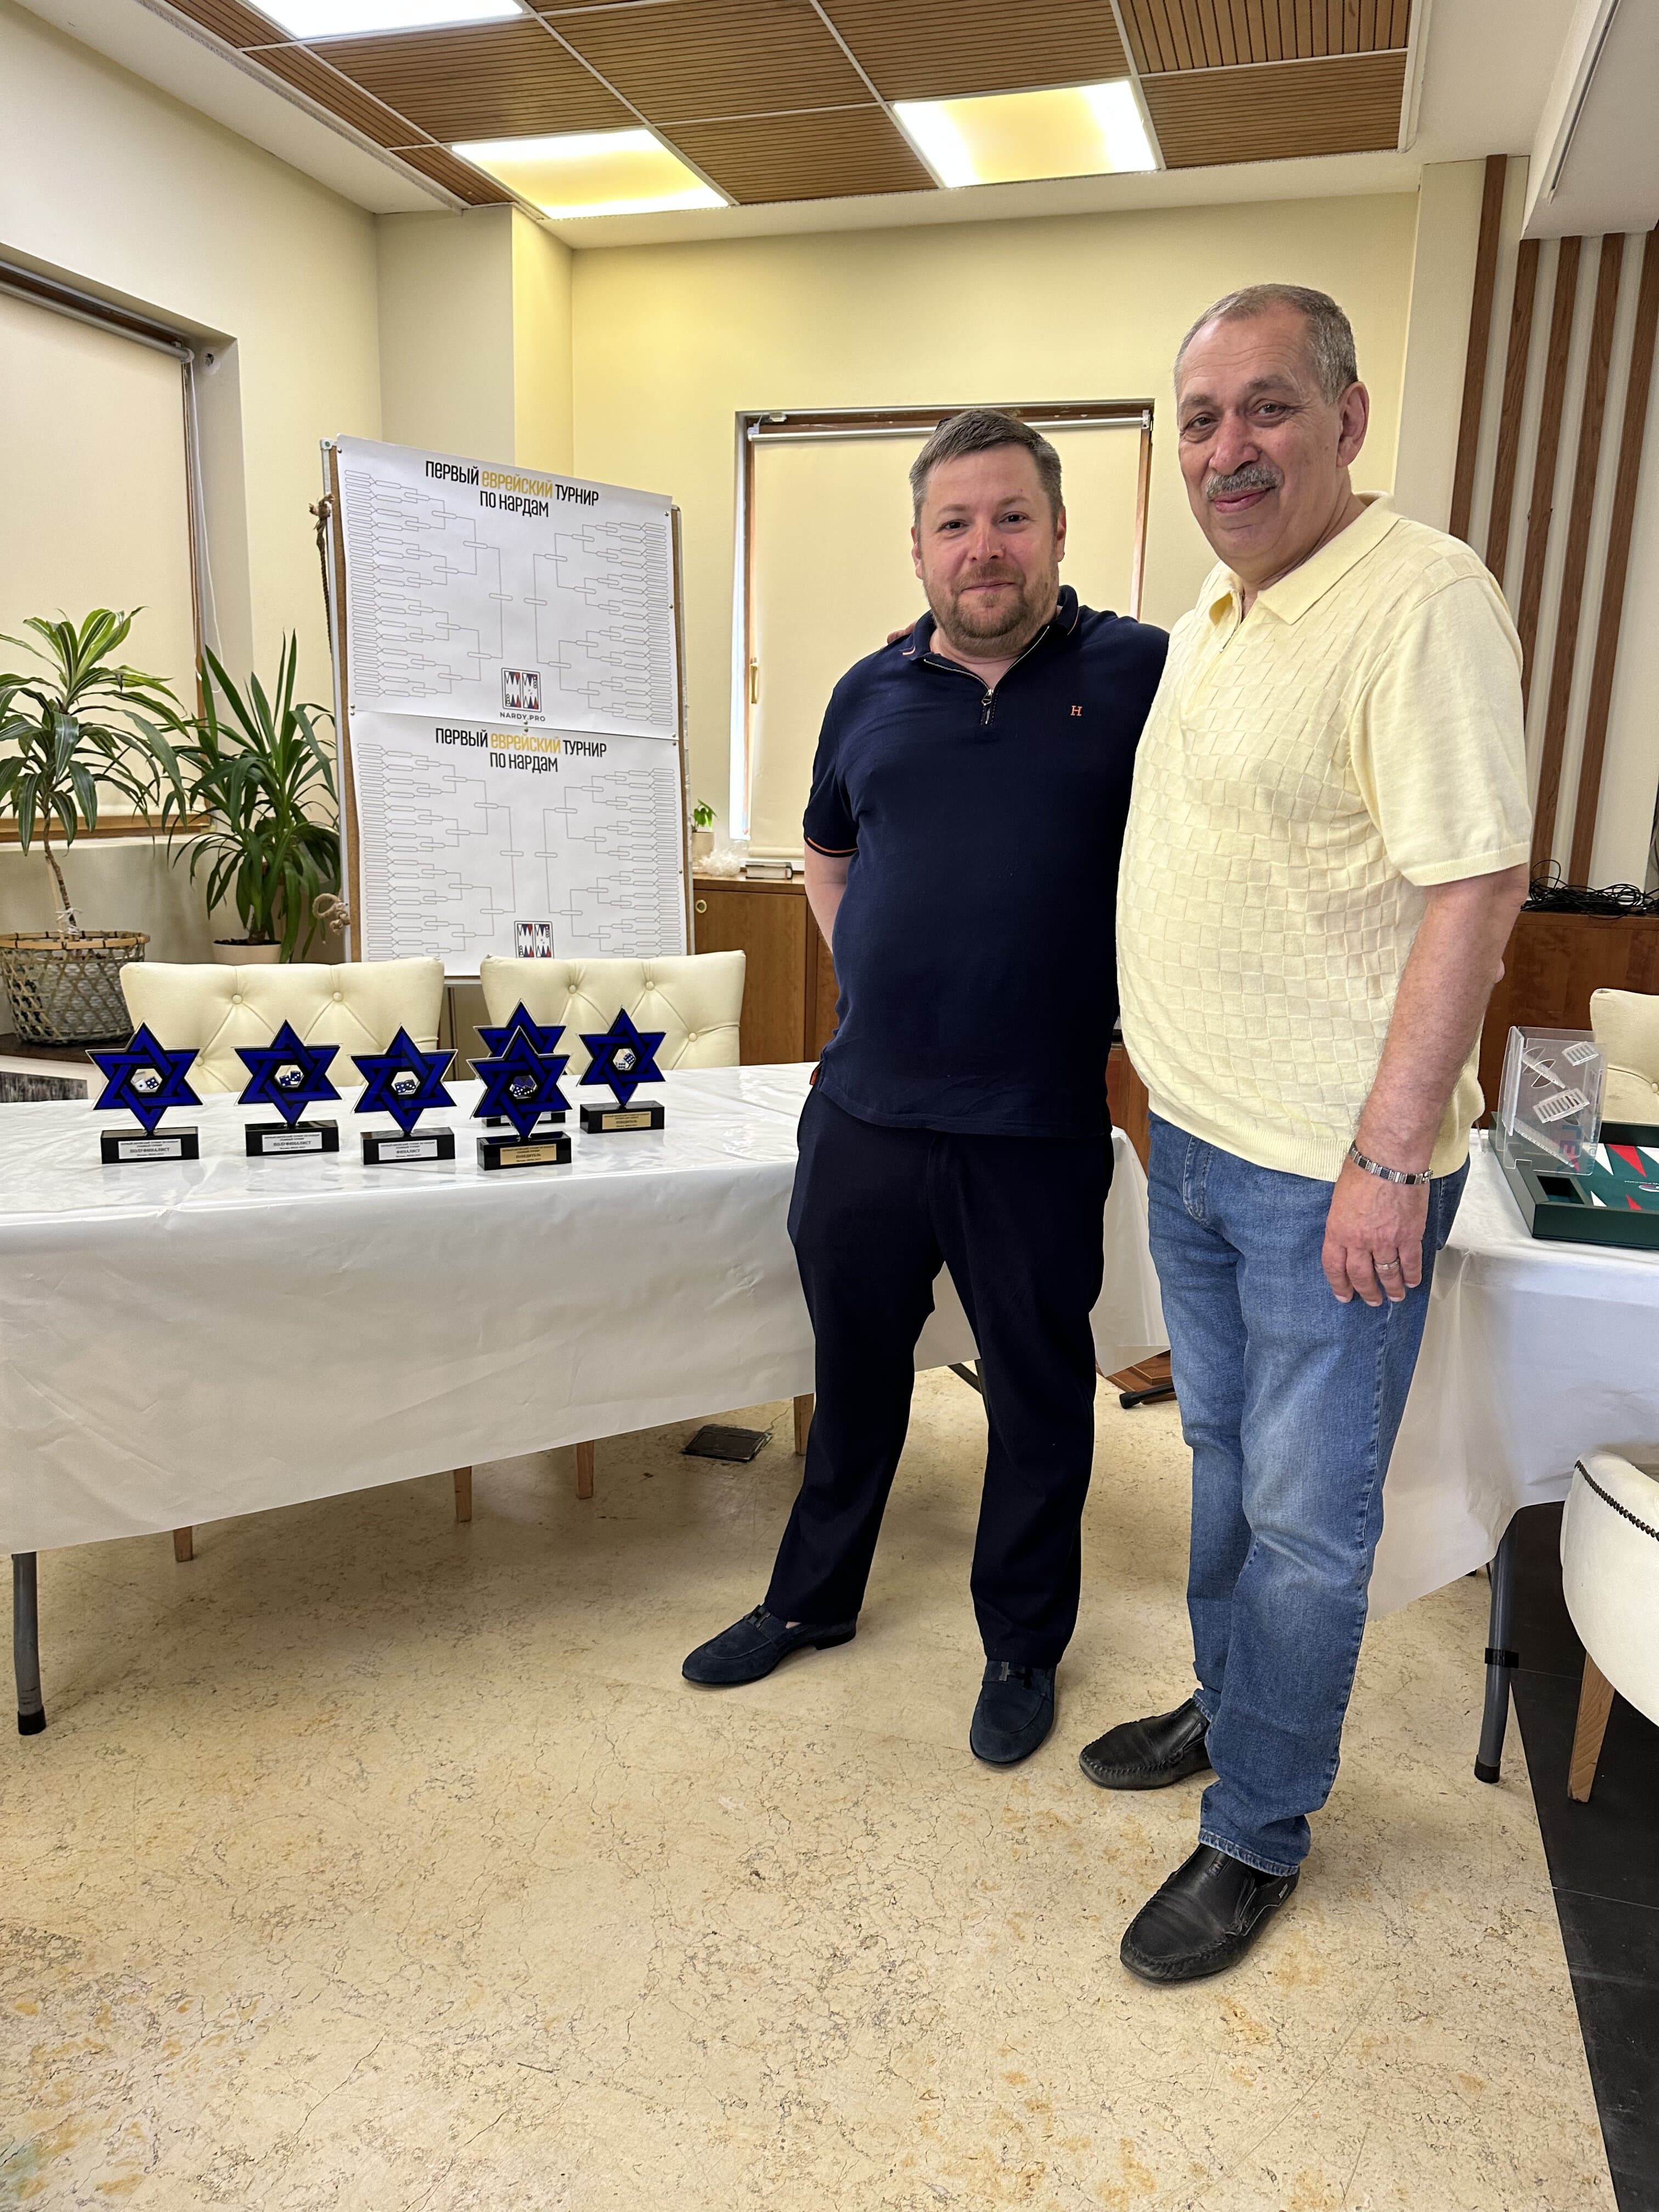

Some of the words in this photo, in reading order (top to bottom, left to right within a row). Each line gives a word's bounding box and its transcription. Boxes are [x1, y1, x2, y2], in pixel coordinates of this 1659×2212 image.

[480, 490, 495, 508] ПО
[555, 484, 599, 506] ТУРНИР
[500, 712, 545, 721] NARDY.PRO
[1070, 705, 1082, 716] H
[563, 740, 607, 758] ТУРНИР
[490, 752, 506, 768] ПО
